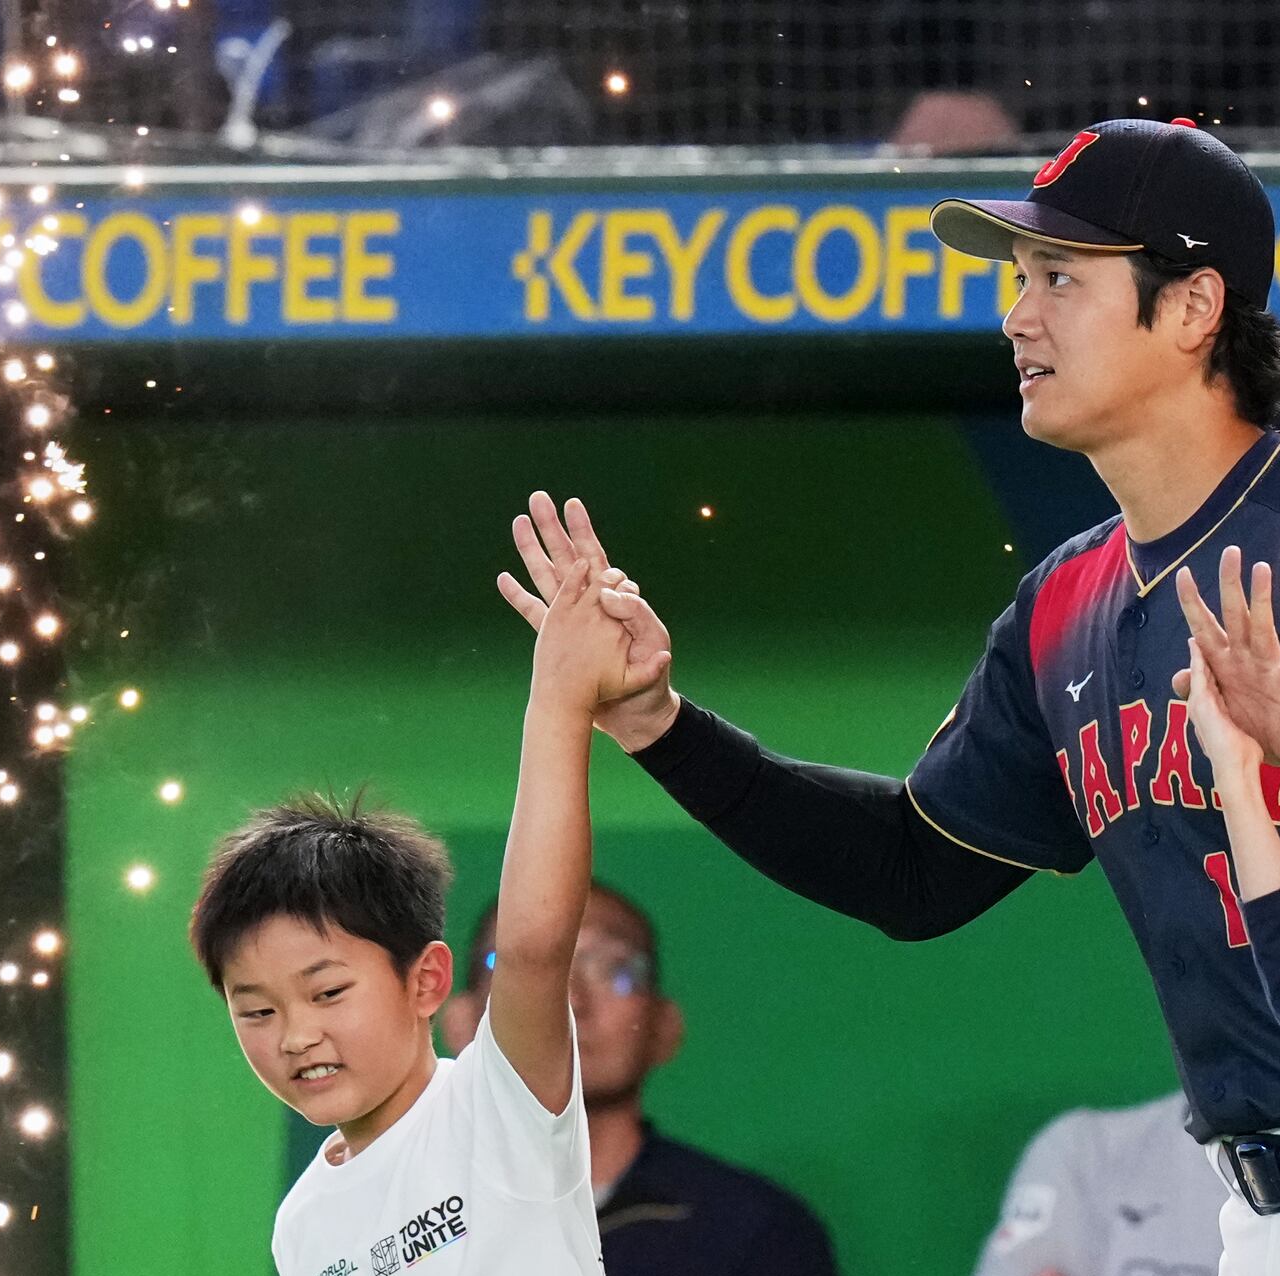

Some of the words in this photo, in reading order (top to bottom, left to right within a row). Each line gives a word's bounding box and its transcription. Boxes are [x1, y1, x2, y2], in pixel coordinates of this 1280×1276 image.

[513, 204, 1019, 322] KEYCOFF
[399, 1195, 464, 1244] TOKYO
[402, 1214, 467, 1263] UNITE
